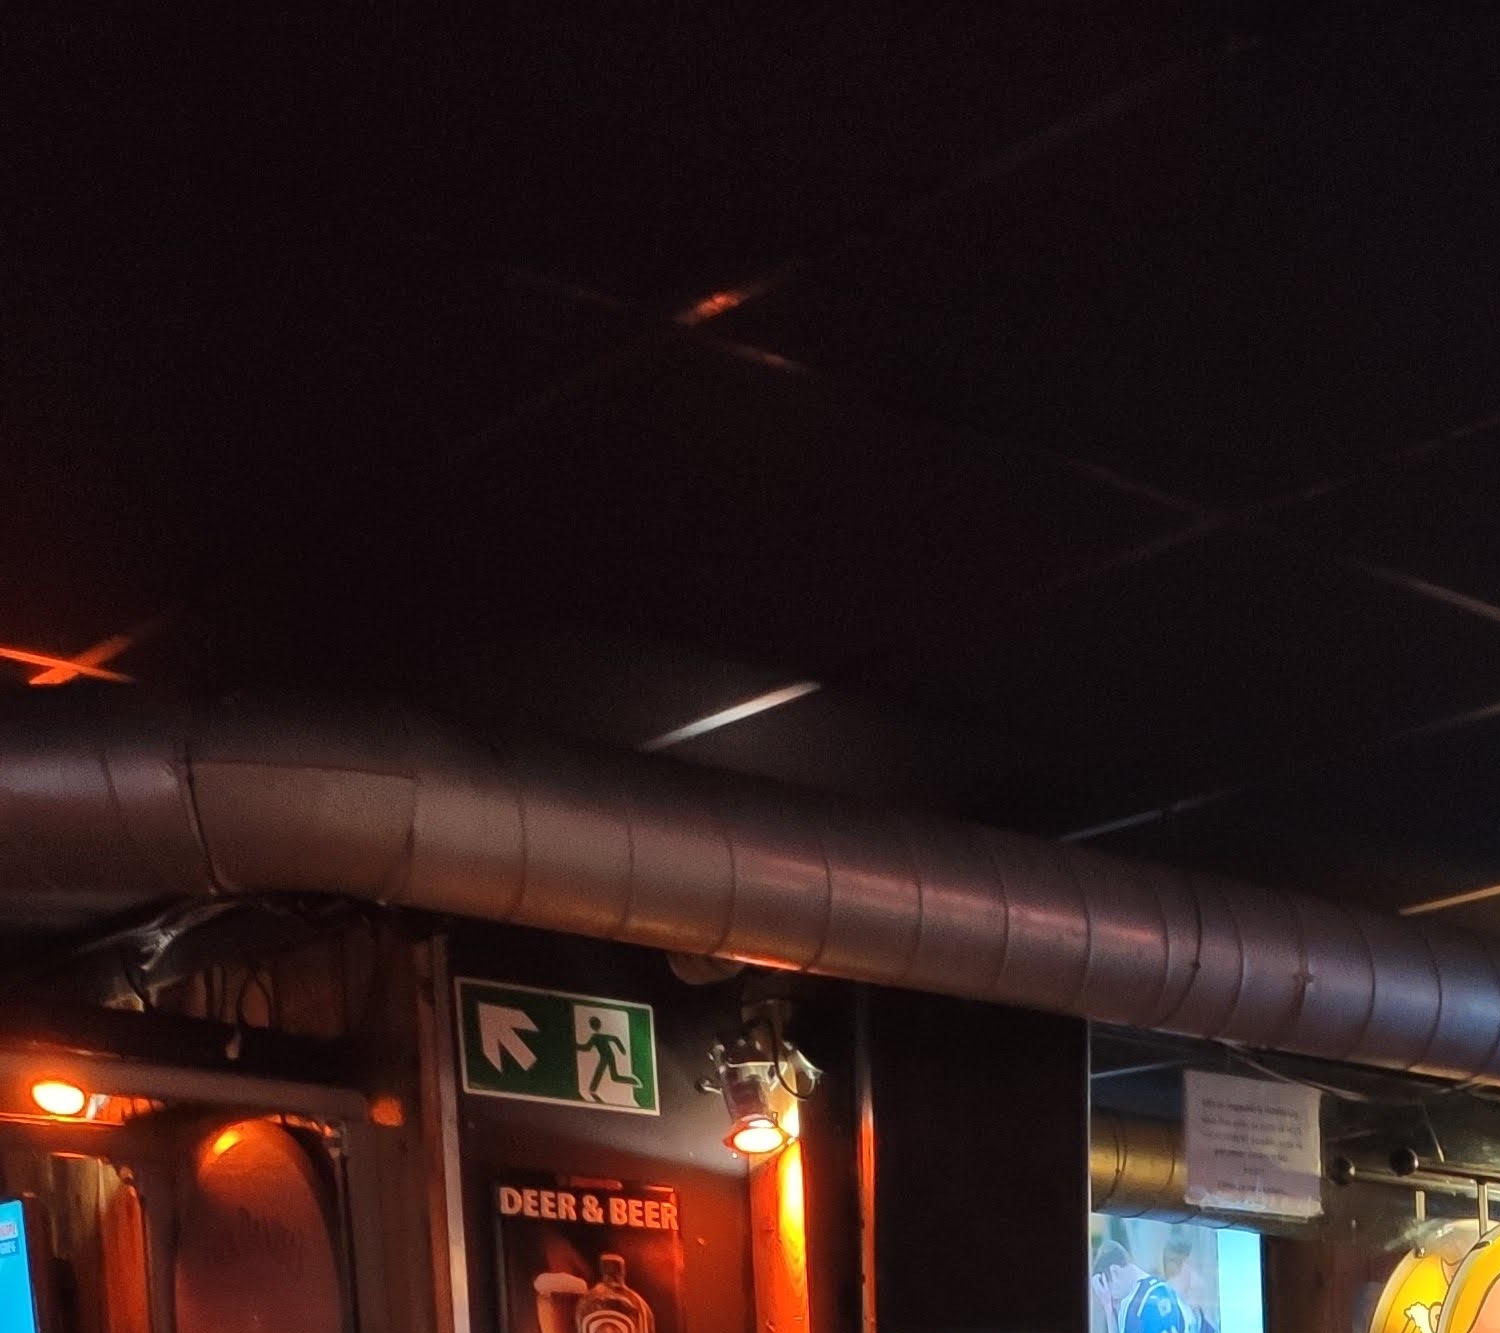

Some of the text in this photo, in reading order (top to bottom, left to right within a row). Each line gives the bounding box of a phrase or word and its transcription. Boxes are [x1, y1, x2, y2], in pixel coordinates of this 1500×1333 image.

[500, 1187, 679, 1231] DEER & BEER
